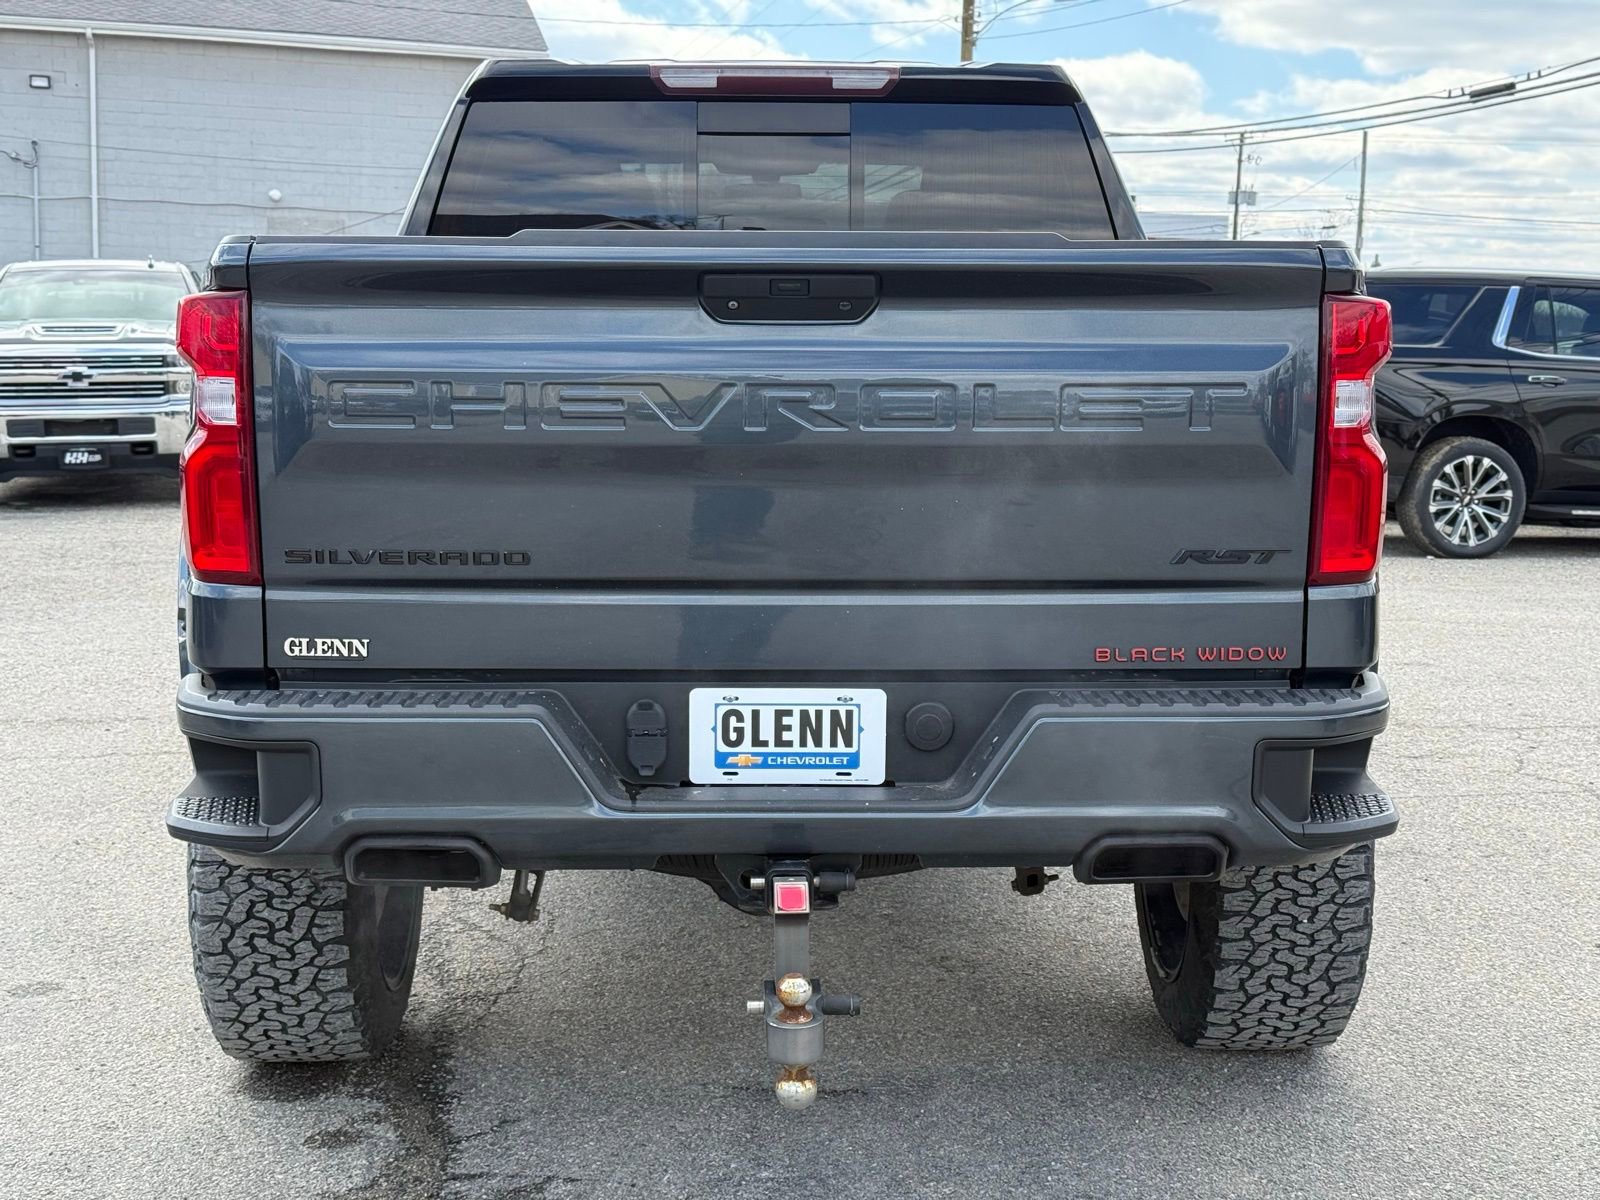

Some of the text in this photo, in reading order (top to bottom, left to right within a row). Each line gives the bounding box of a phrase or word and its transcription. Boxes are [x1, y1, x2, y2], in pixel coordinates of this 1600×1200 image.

[327, 379, 1249, 432] CHEVROLET
[284, 549, 532, 566] SILVERADO
[1168, 549, 1293, 565] RST
[283, 637, 370, 658] GLENN
[1094, 646, 1288, 663] BLACK WIDOW
[721, 708, 854, 749] GLENN
[767, 756, 850, 766] CHEVROLET
